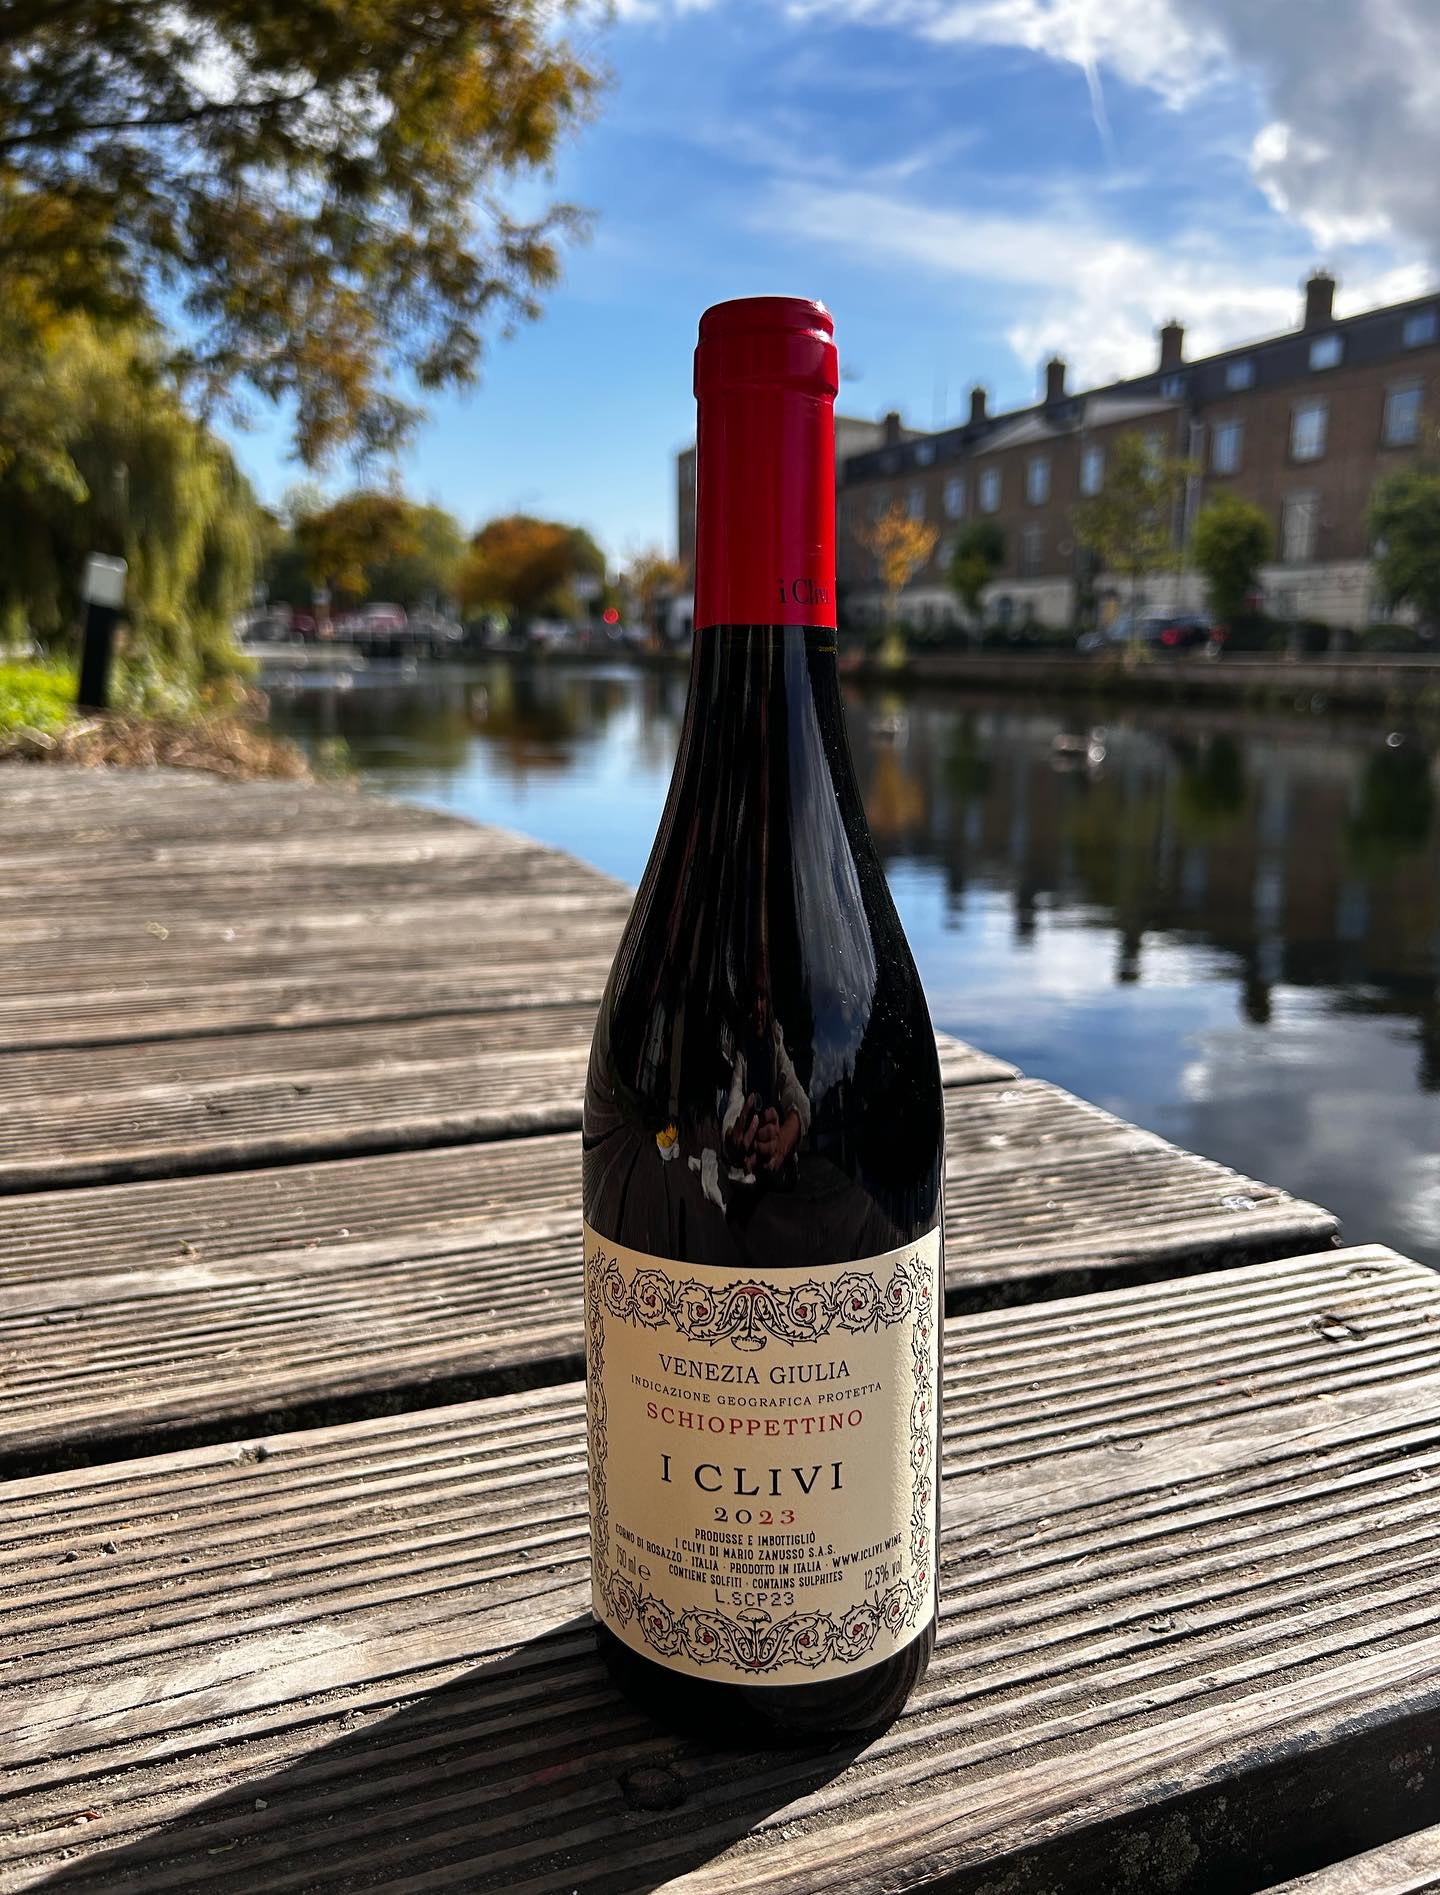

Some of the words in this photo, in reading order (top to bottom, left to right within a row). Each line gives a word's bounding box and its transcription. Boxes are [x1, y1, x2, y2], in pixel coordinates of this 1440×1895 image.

[779, 578, 787, 605] i
[658, 1353, 760, 1385] VENEZIA
[769, 1360, 850, 1385] GIULIA
[631, 1374, 711, 1403] INDICAZIONE
[717, 1395, 812, 1407] GEOGRAFICA
[818, 1382, 882, 1404] PROTETTA
[647, 1402, 863, 1436] SCHIOPPETTINO
[661, 1453, 672, 1483] I
[694, 1462, 843, 1496] CLIVI
[713, 1506, 796, 1525] 2023
[615, 1523, 635, 1544] CORNO
[637, 1536, 644, 1549] DI
[646, 1540, 682, 1563] ROSAZZO
[691, 1556, 719, 1571] ITALIA
[730, 1562, 775, 1575] PRODOTTO
[779, 1563, 789, 1575] IN
[793, 1560, 822, 1574] ITALIA
[832, 1532, 902, 1568] WWW.ICLIVI.WINE
[675, 1537, 679, 1549] I
[682, 1539, 705, 1555] CLIVI
[709, 1545, 719, 1557] DI
[723, 1547, 754, 1560] MARIO
[758, 1548, 804, 1561] ZANUSSO
[808, 1544, 836, 1558] S.A.S.
[695, 1528, 743, 1546] PRODUSSE
[748, 1535, 754, 1546] E
[668, 1563, 707, 1584] CONTIENE
[710, 1574, 742, 1588] SOLFITI
[752, 1577, 795, 1589] CONTAINS
[799, 1570, 843, 1588] SULPHITES
[864, 1561, 890, 1590] 12.5%
[715, 1588, 794, 1607] L.SCP23
